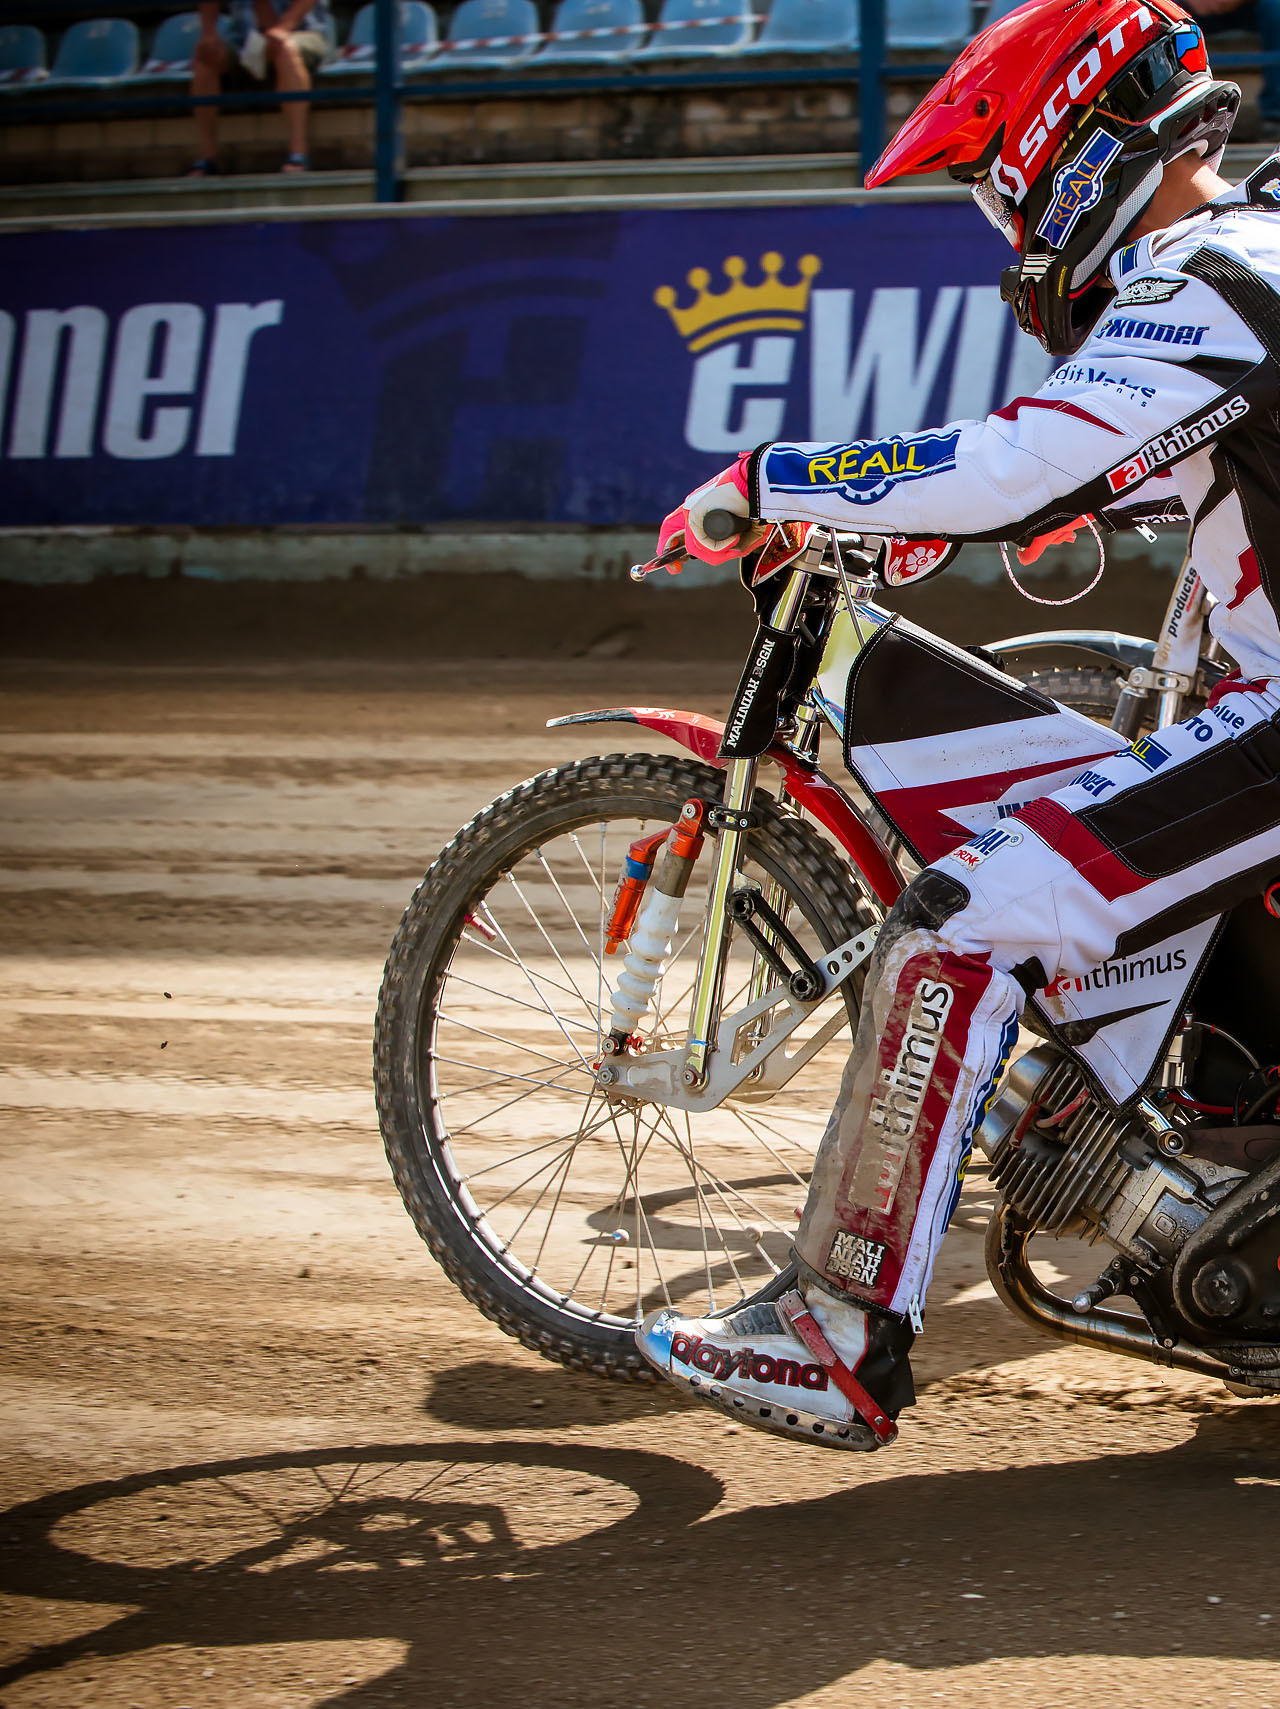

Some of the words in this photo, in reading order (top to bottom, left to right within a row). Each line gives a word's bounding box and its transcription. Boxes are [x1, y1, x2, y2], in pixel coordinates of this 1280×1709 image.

[1053, 160, 1102, 227] REALL
[0, 300, 283, 460] ner
[809, 443, 925, 484] REALL
[1123, 396, 1250, 486] althimus
[870, 982, 949, 1190] thimus
[671, 1330, 829, 1391] daytona
